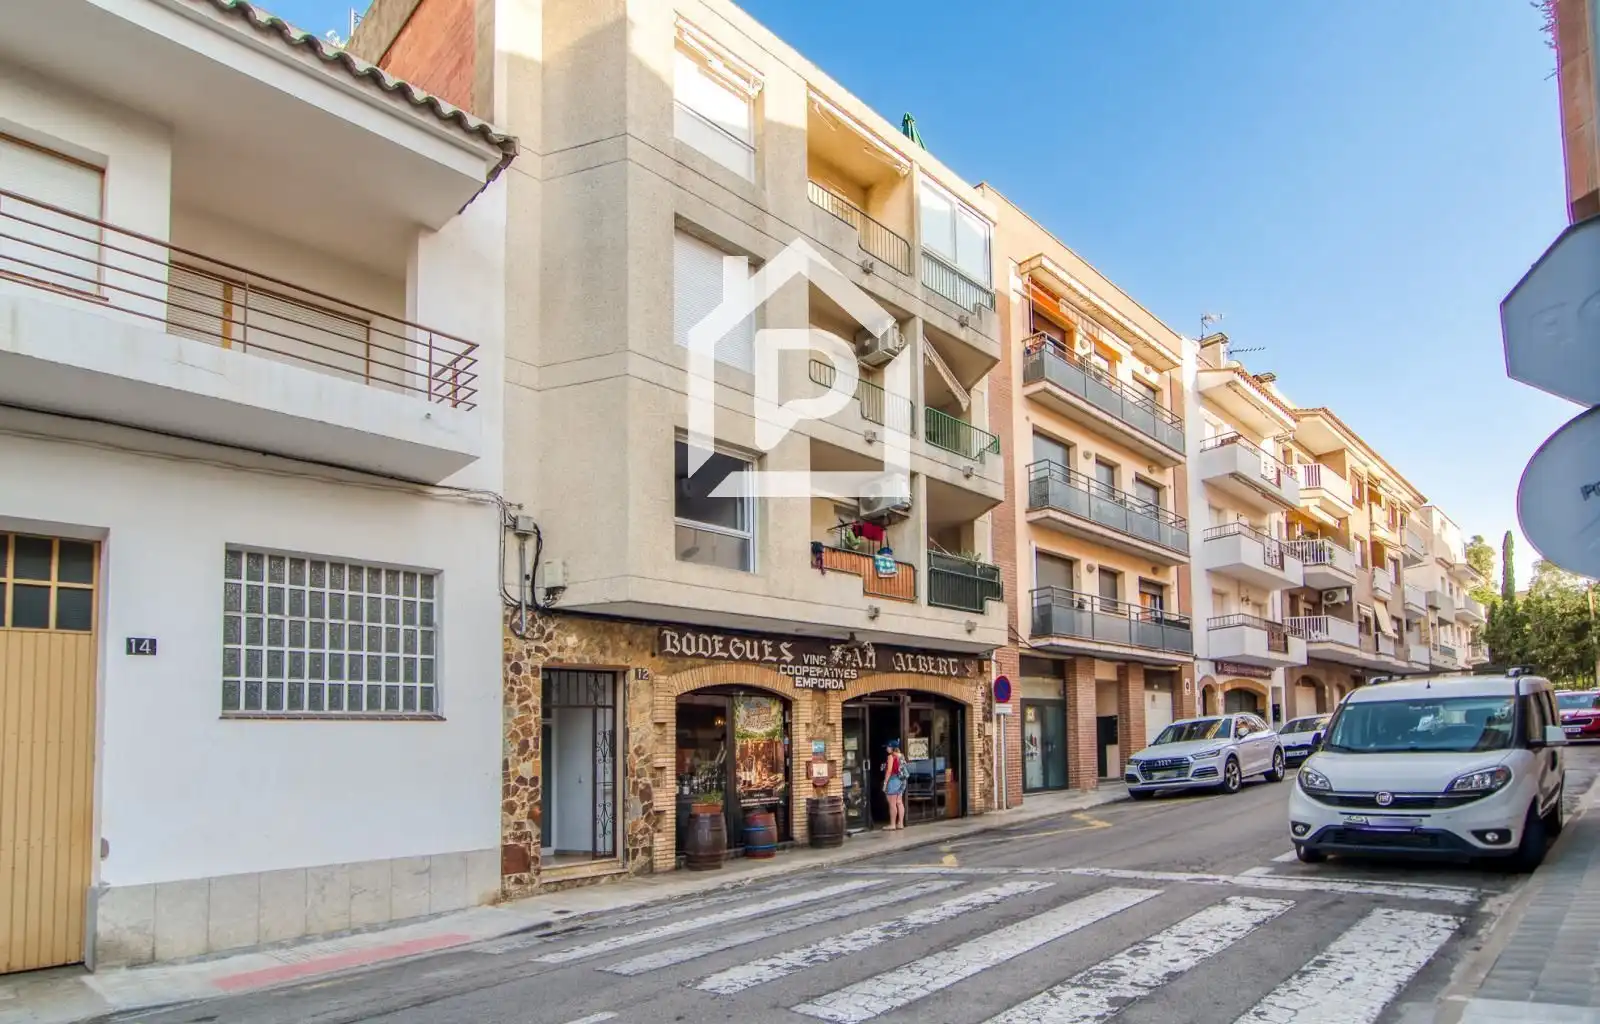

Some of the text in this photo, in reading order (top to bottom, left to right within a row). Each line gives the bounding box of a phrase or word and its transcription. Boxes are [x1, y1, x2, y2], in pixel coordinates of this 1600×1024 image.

[130, 638, 152, 654] 14
[661, 630, 795, 662] BODEGUES
[892, 652, 959, 676] ALBERT
[803, 653, 827, 666] VINS
[638, 668, 649, 680] 12
